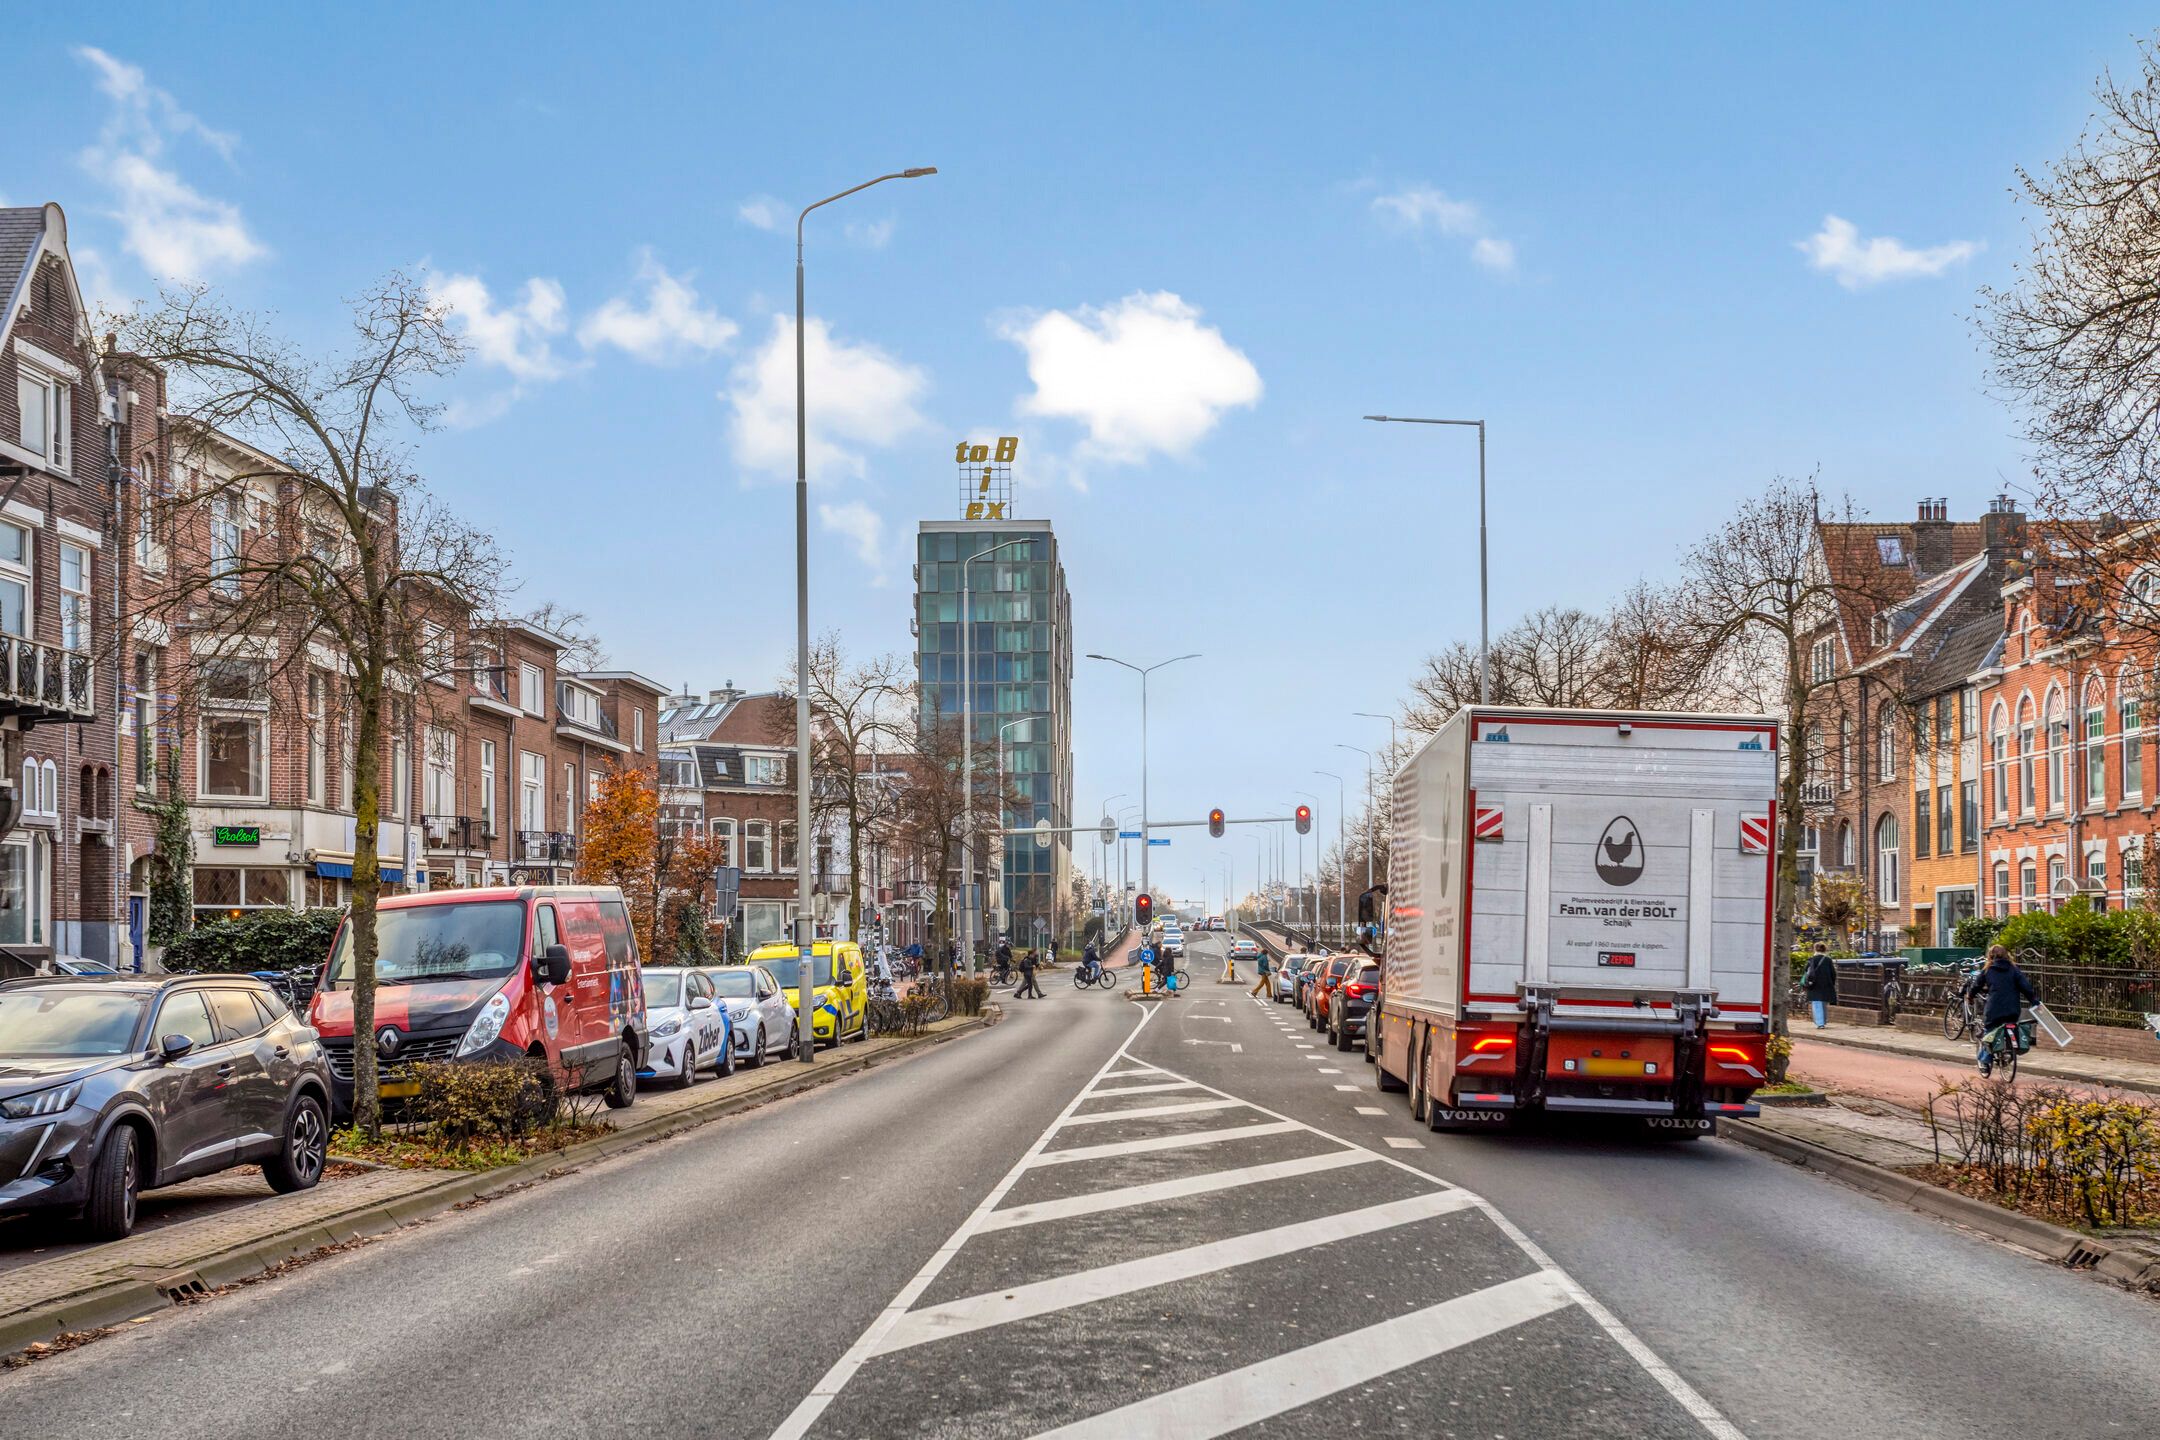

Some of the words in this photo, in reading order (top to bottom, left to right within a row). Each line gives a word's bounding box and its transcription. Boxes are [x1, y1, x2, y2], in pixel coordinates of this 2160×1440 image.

[966, 503, 1007, 520] ex
[217, 827, 258, 844] Grolsch
[529, 869, 549, 881] MEX
[1560, 904, 1591, 916] Fam.
[1593, 907, 1617, 917] van
[1619, 906, 1640, 917] der
[1643, 907, 1677, 918] BOLT
[1603, 919, 1632, 928] Schaijk
[1610, 955, 1634, 965] ZEPRO
[1439, 1110, 1505, 1121] VOLVO
[1645, 1117, 1711, 1129] VOLVO
